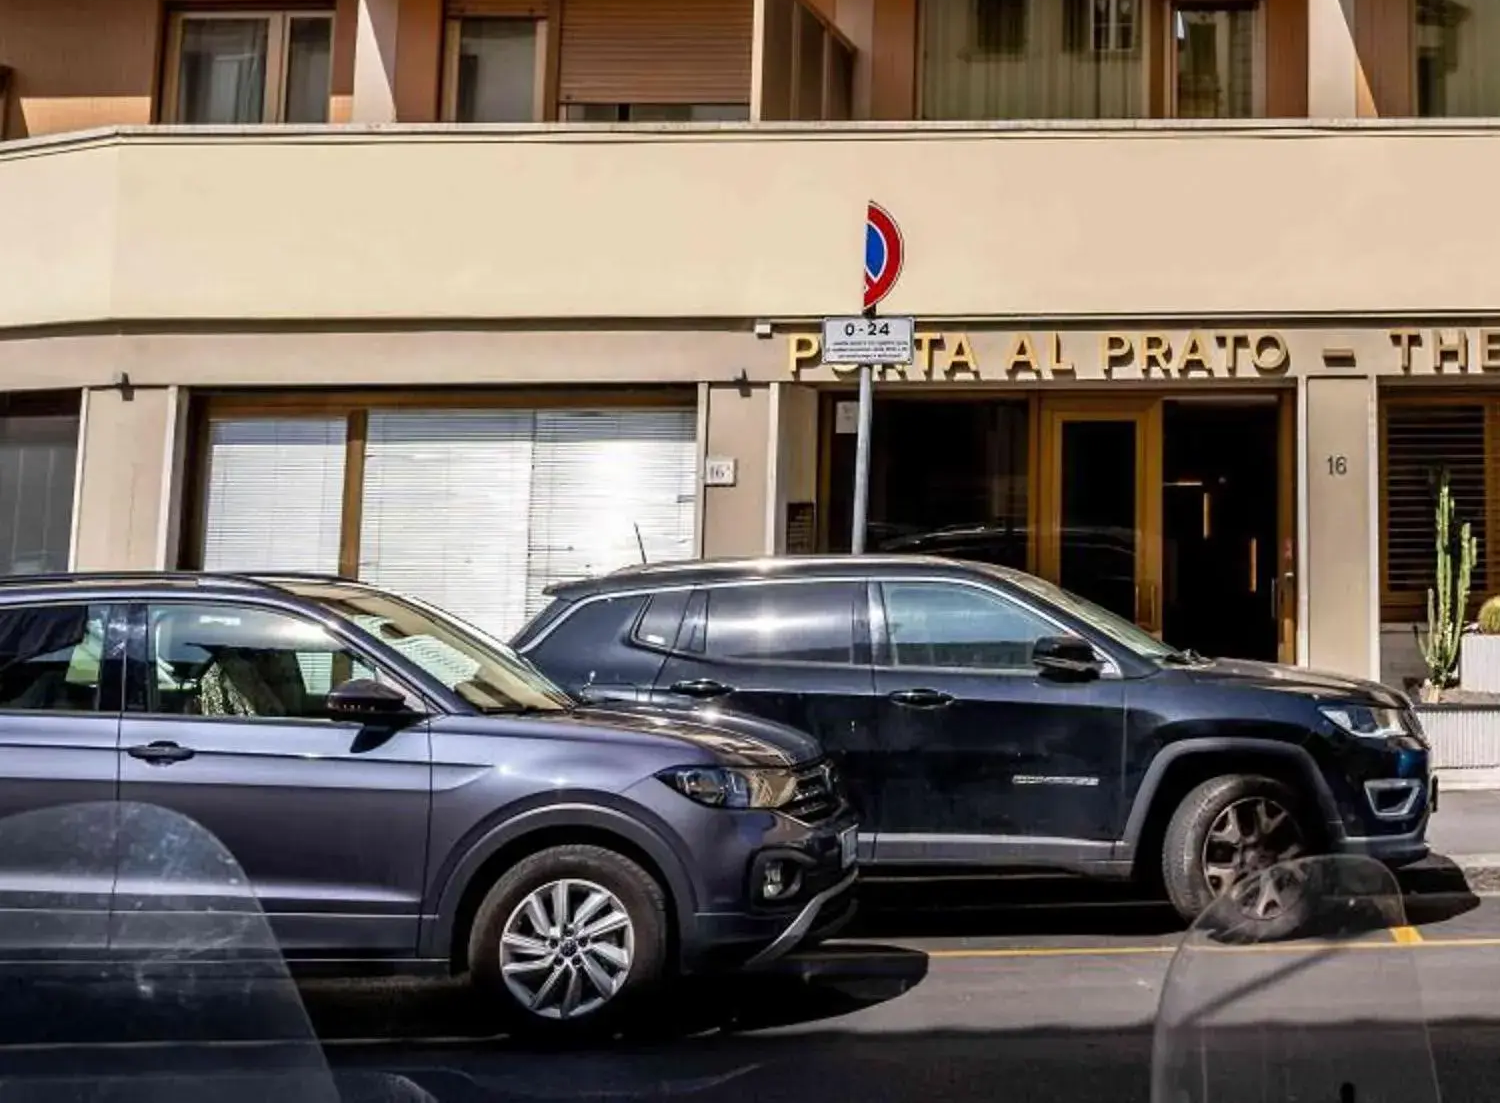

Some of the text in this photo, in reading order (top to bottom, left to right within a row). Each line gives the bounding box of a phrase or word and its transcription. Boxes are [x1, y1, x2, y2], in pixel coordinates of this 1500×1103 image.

[787, 332, 980, 374] PTA
[1006, 331, 1075, 374] AL
[1101, 330, 1289, 374] PRATO
[1327, 455, 1347, 476] 16
